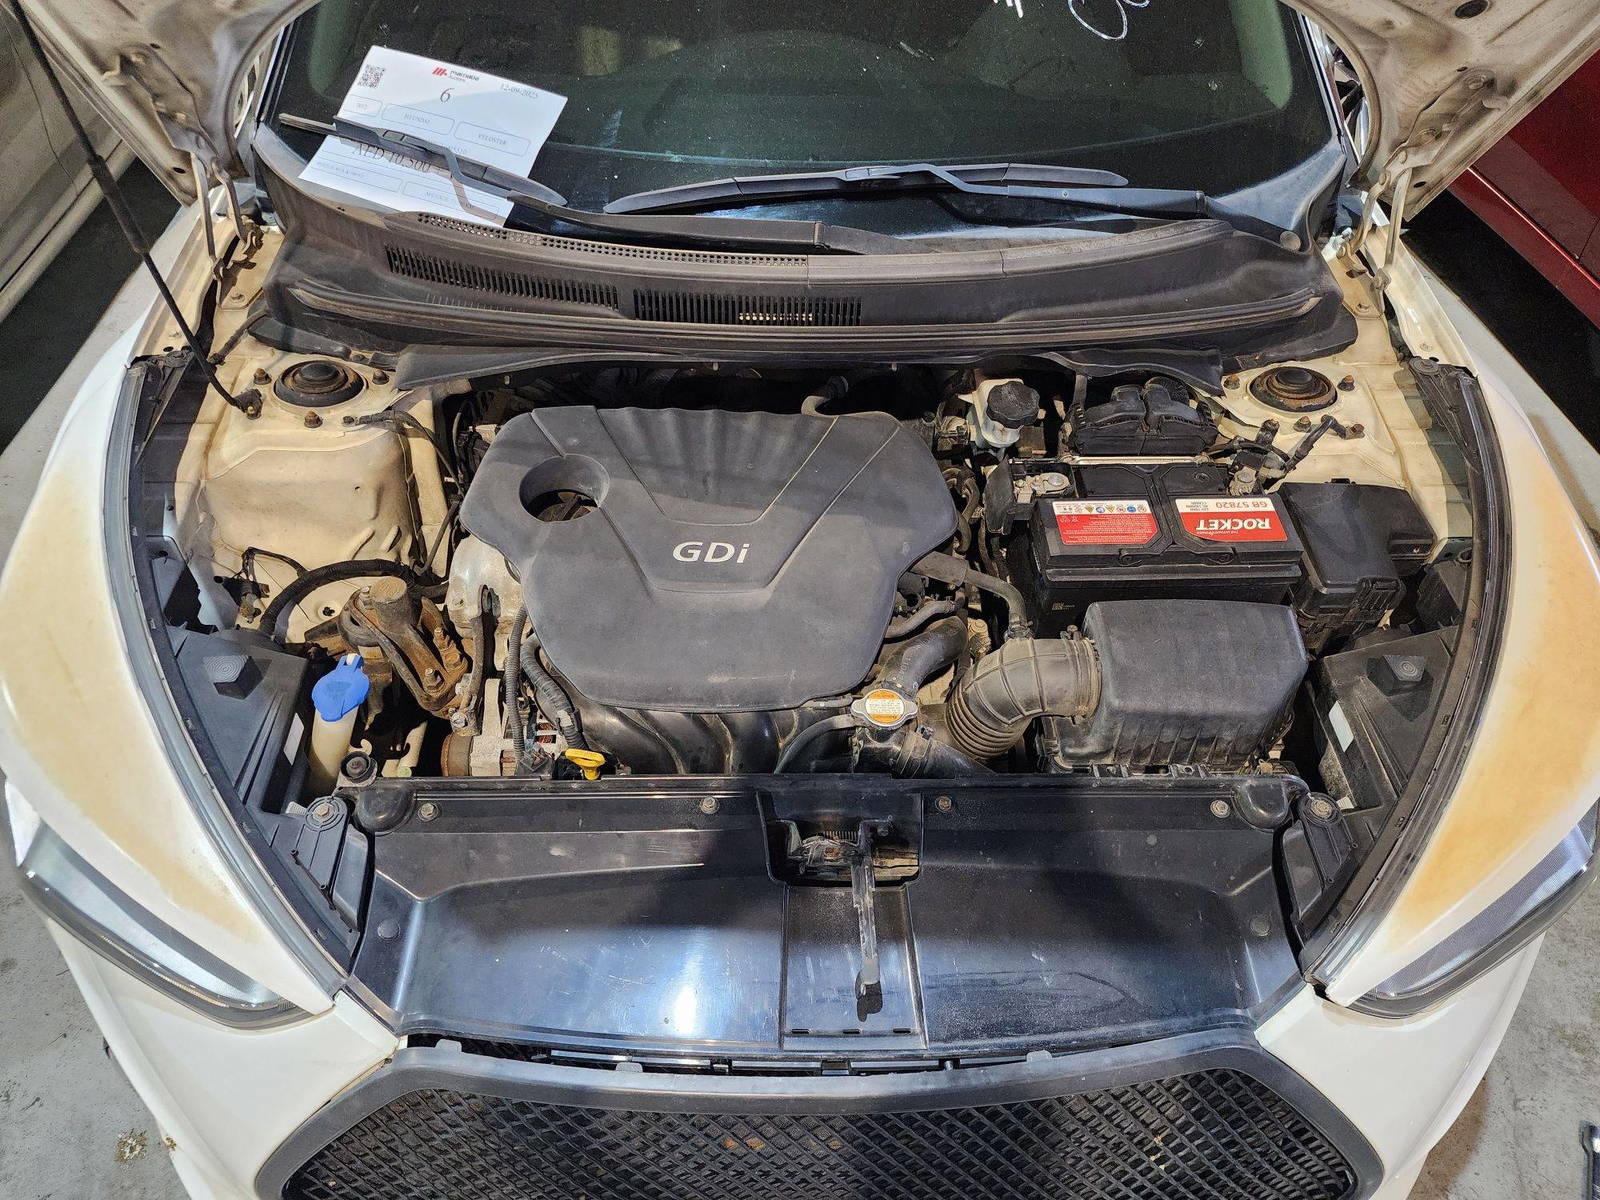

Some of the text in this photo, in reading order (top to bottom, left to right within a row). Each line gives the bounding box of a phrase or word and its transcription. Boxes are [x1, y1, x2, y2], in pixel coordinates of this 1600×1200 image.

[439, 87, 455, 103] 6
[353, 142, 386, 160] AED
[1215, 501, 1250, 509] 57820
[1251, 501, 1268, 509] GB
[1195, 518, 1272, 531] ROCKET
[672, 541, 750, 564] GDi
